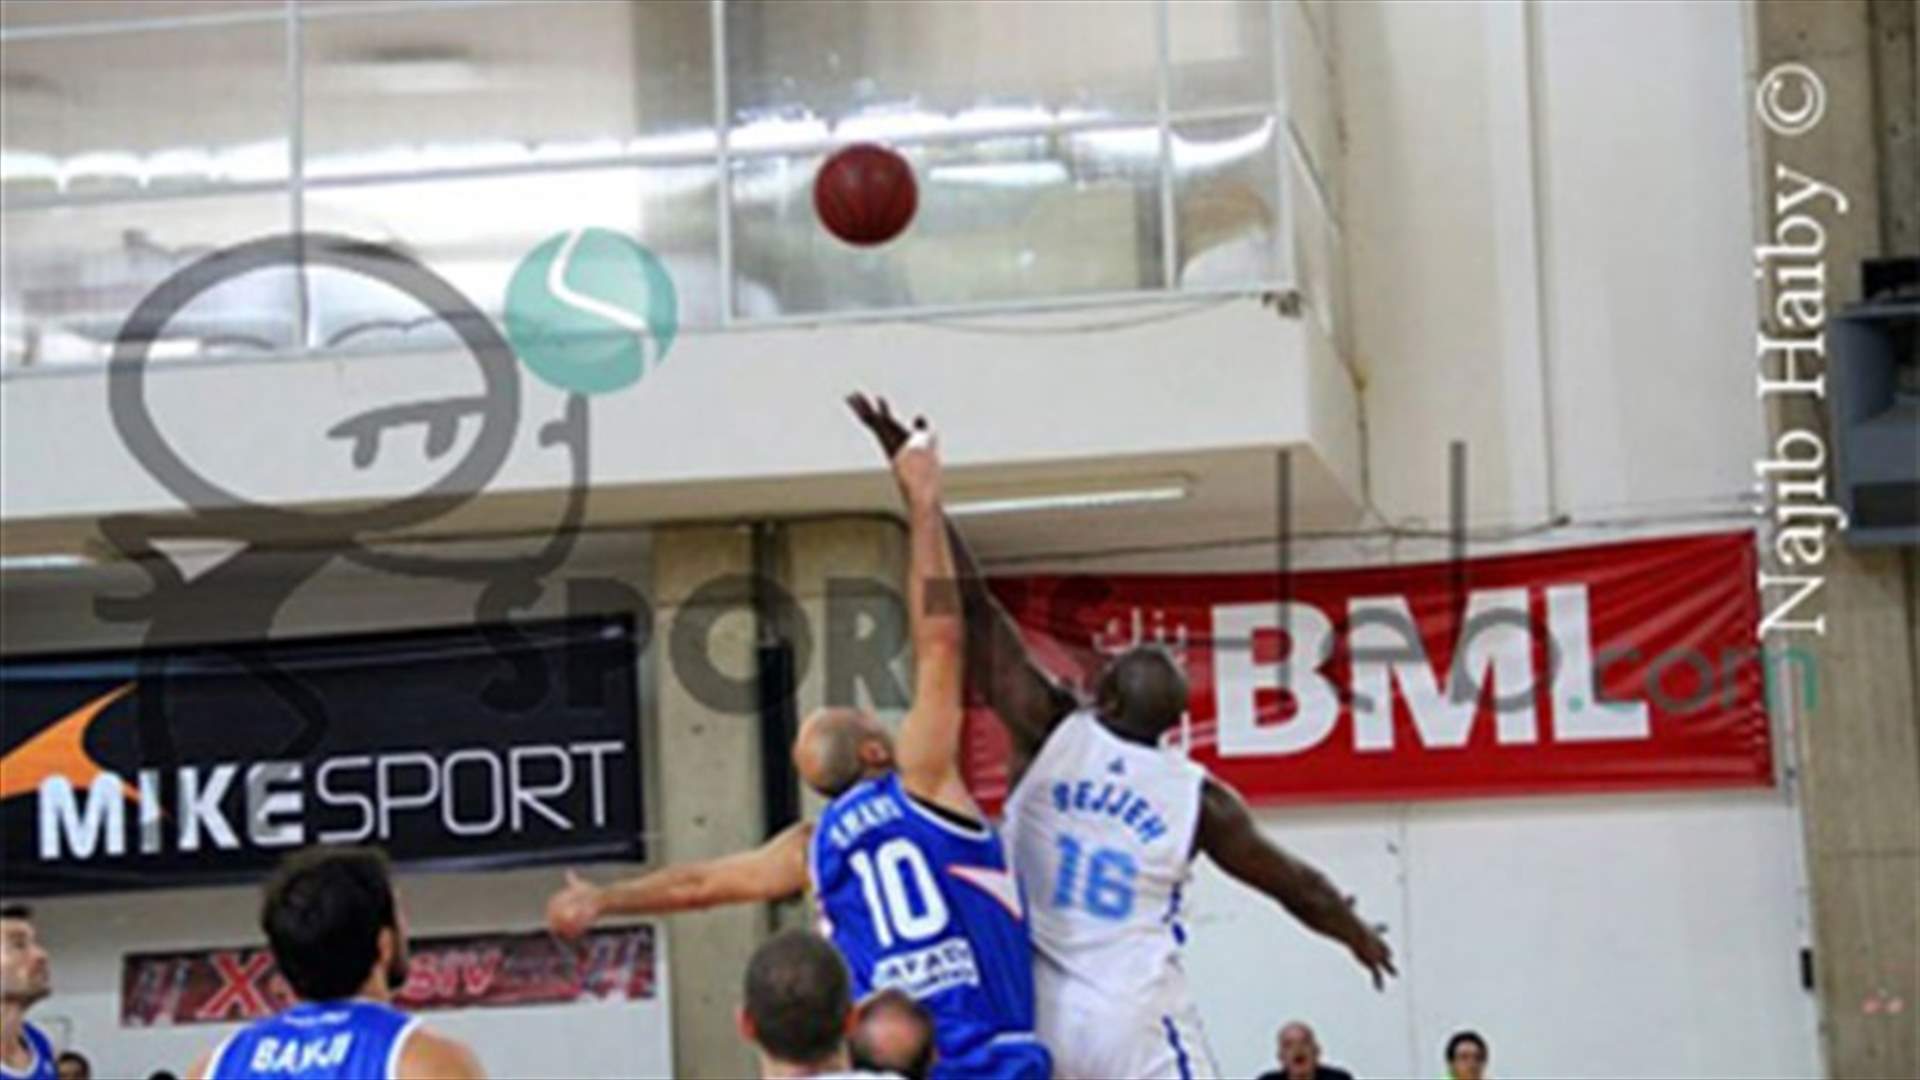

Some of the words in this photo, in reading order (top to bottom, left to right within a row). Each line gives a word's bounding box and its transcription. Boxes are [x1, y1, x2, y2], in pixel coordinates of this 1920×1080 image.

[1209, 583, 1648, 759] BML
[848, 837, 949, 948] 10
[1053, 835, 1138, 919] 16
